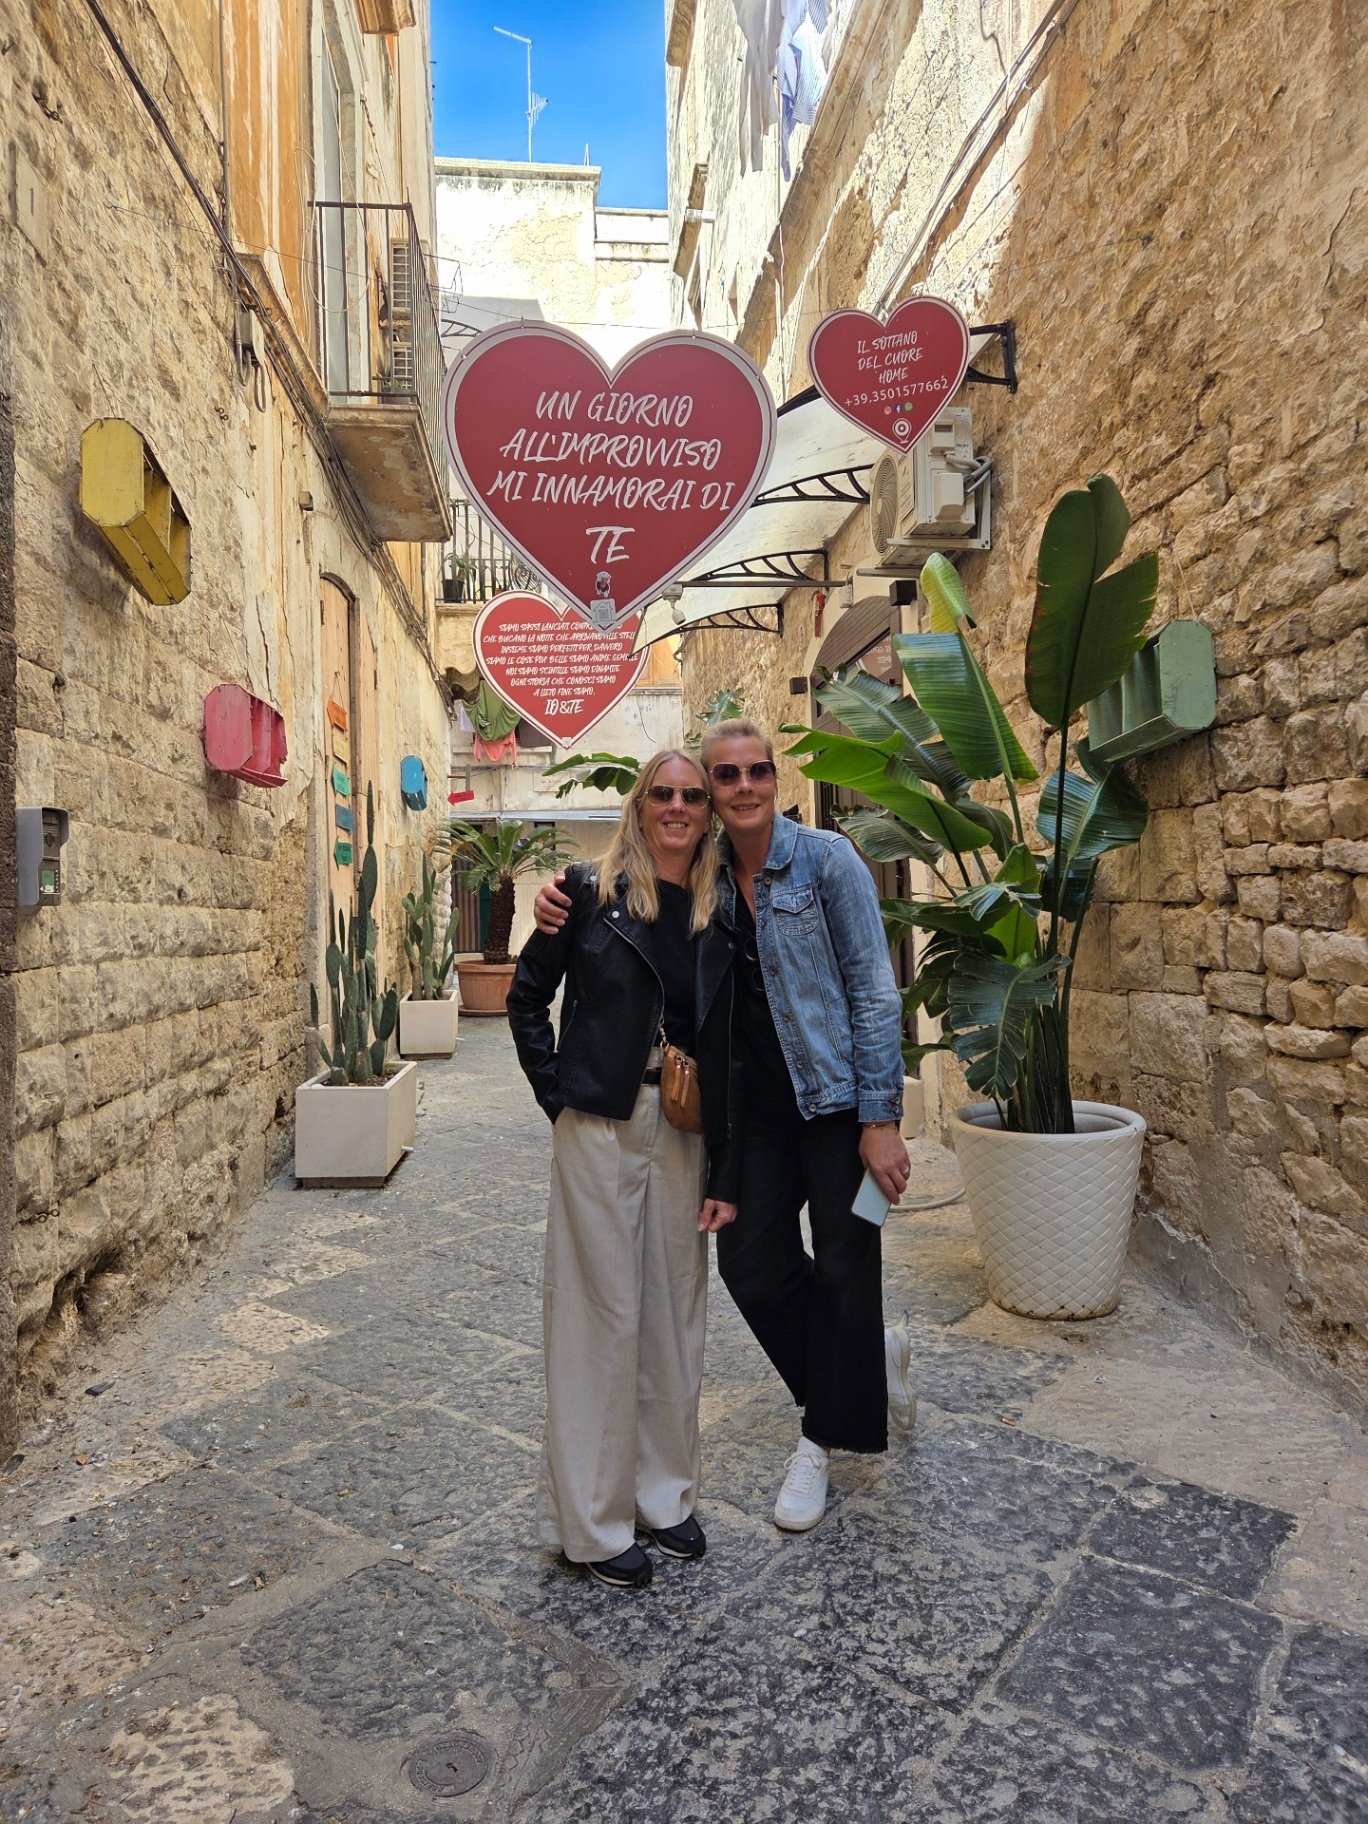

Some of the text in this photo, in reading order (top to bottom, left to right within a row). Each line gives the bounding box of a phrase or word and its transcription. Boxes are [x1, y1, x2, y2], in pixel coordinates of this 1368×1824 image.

[857, 330, 918, 354] IL SOTTANO
[857, 347, 924, 371] DEL CUORE
[878, 367, 909, 385] HOME
[844, 378, 949, 406] +39.3501577662
[535, 389, 695, 428] UN GIORNO
[499, 427, 722, 471] ALL'IMPROVVISO
[486, 470, 737, 512] MI INNAMORAI DI
[585, 525, 636, 565] TE
[498, 623, 520, 632] SIAMO
[520, 622, 541, 631] SASSI
[541, 621, 571, 631] LANCIATI
[483, 634, 498, 643] CHE
[498, 633, 527, 643] BUCANO
[527, 633, 535, 643] LA
[536, 633, 555, 642] NOTTE
[556, 632, 570, 641] CHE
[501, 641, 623, 654] INSIEME SIAMO PERFETTI PER DAVVERO
[486, 656, 507, 665] SIAMO
[507, 656, 516, 665] LE
[516, 655, 535, 665] COSE
[549, 654, 569, 664] BELLE
[569, 654, 590, 663] SIAMO
[590, 653, 611, 662] ANIME
[506, 664, 621, 675] NOI SIAMO SCINTILLE SIAMO DINAMITE
[511, 675, 617, 687] OGNI STORIA CHE CONOSCI SIAMO
[533, 688, 540, 696] A
[540, 688, 557, 697] LIETO
[557, 687, 573, 696] FINE
